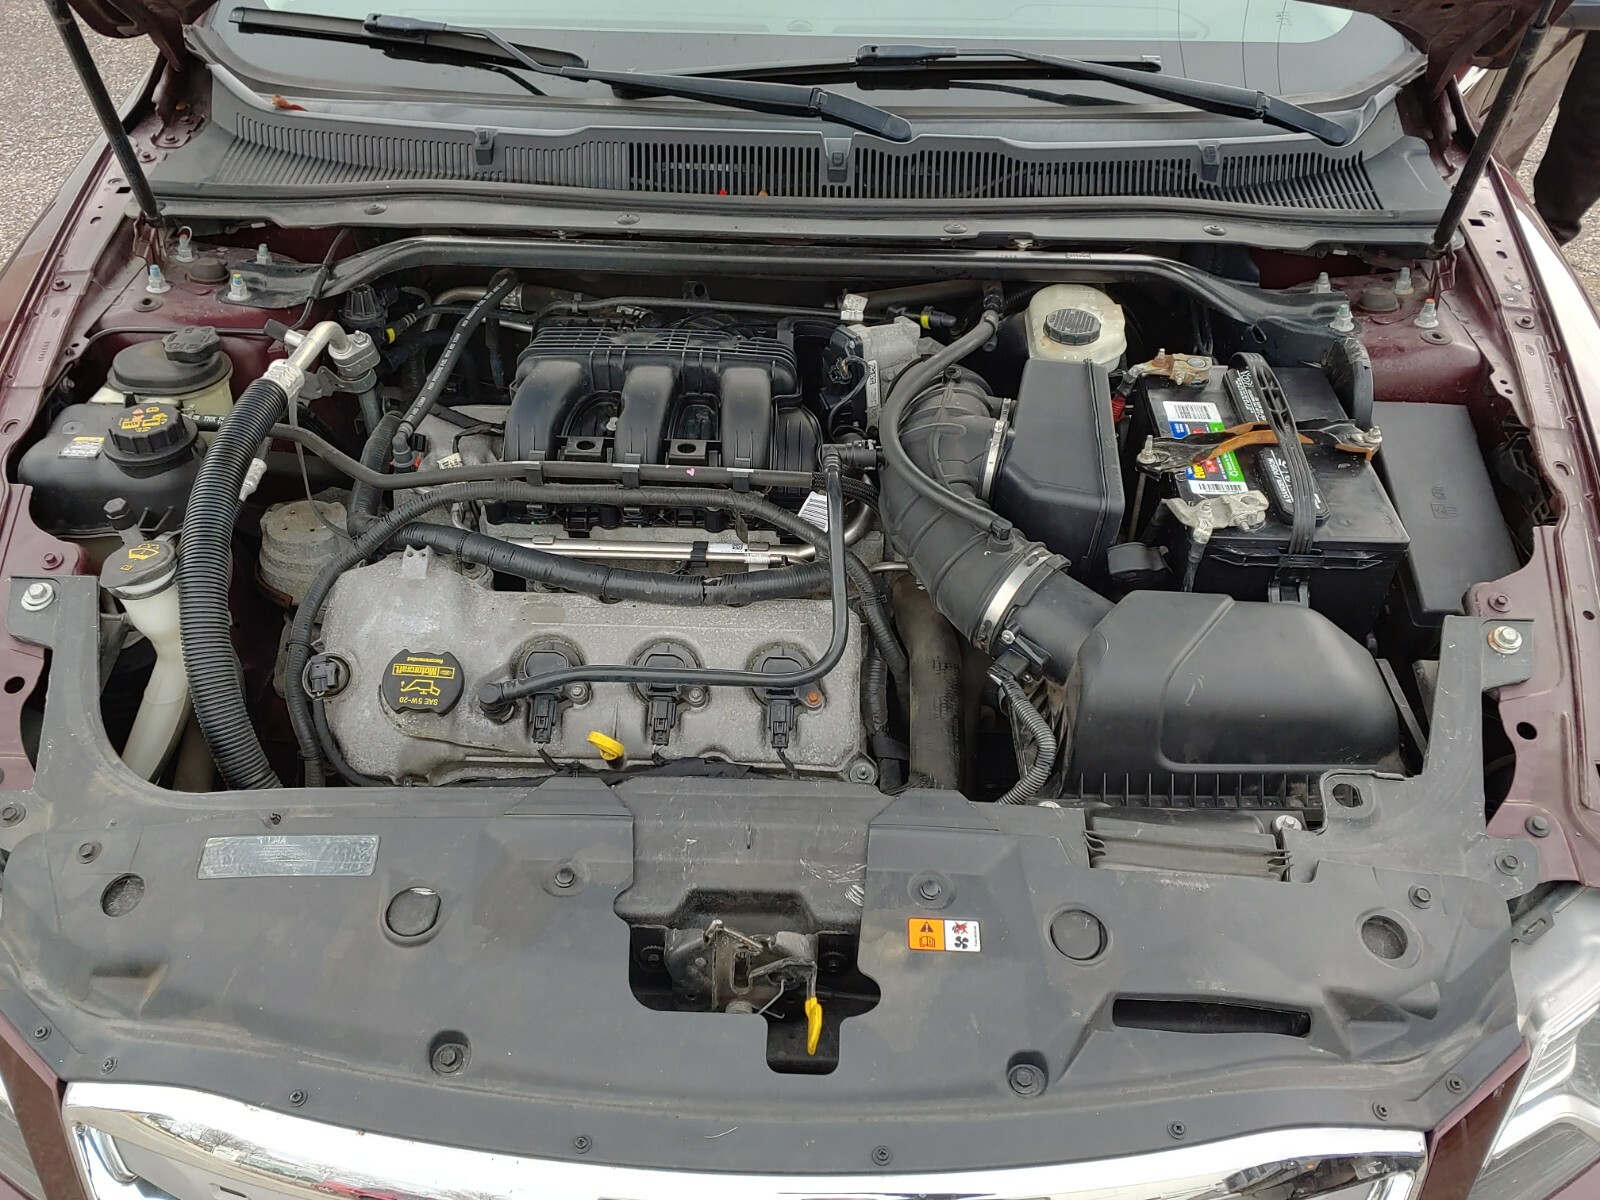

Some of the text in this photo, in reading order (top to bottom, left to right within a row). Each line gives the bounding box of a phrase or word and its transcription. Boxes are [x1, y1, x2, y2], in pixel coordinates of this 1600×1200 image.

[395, 665, 438, 676] Motorcraft
[399, 696, 439, 706] SAE 5W-20
